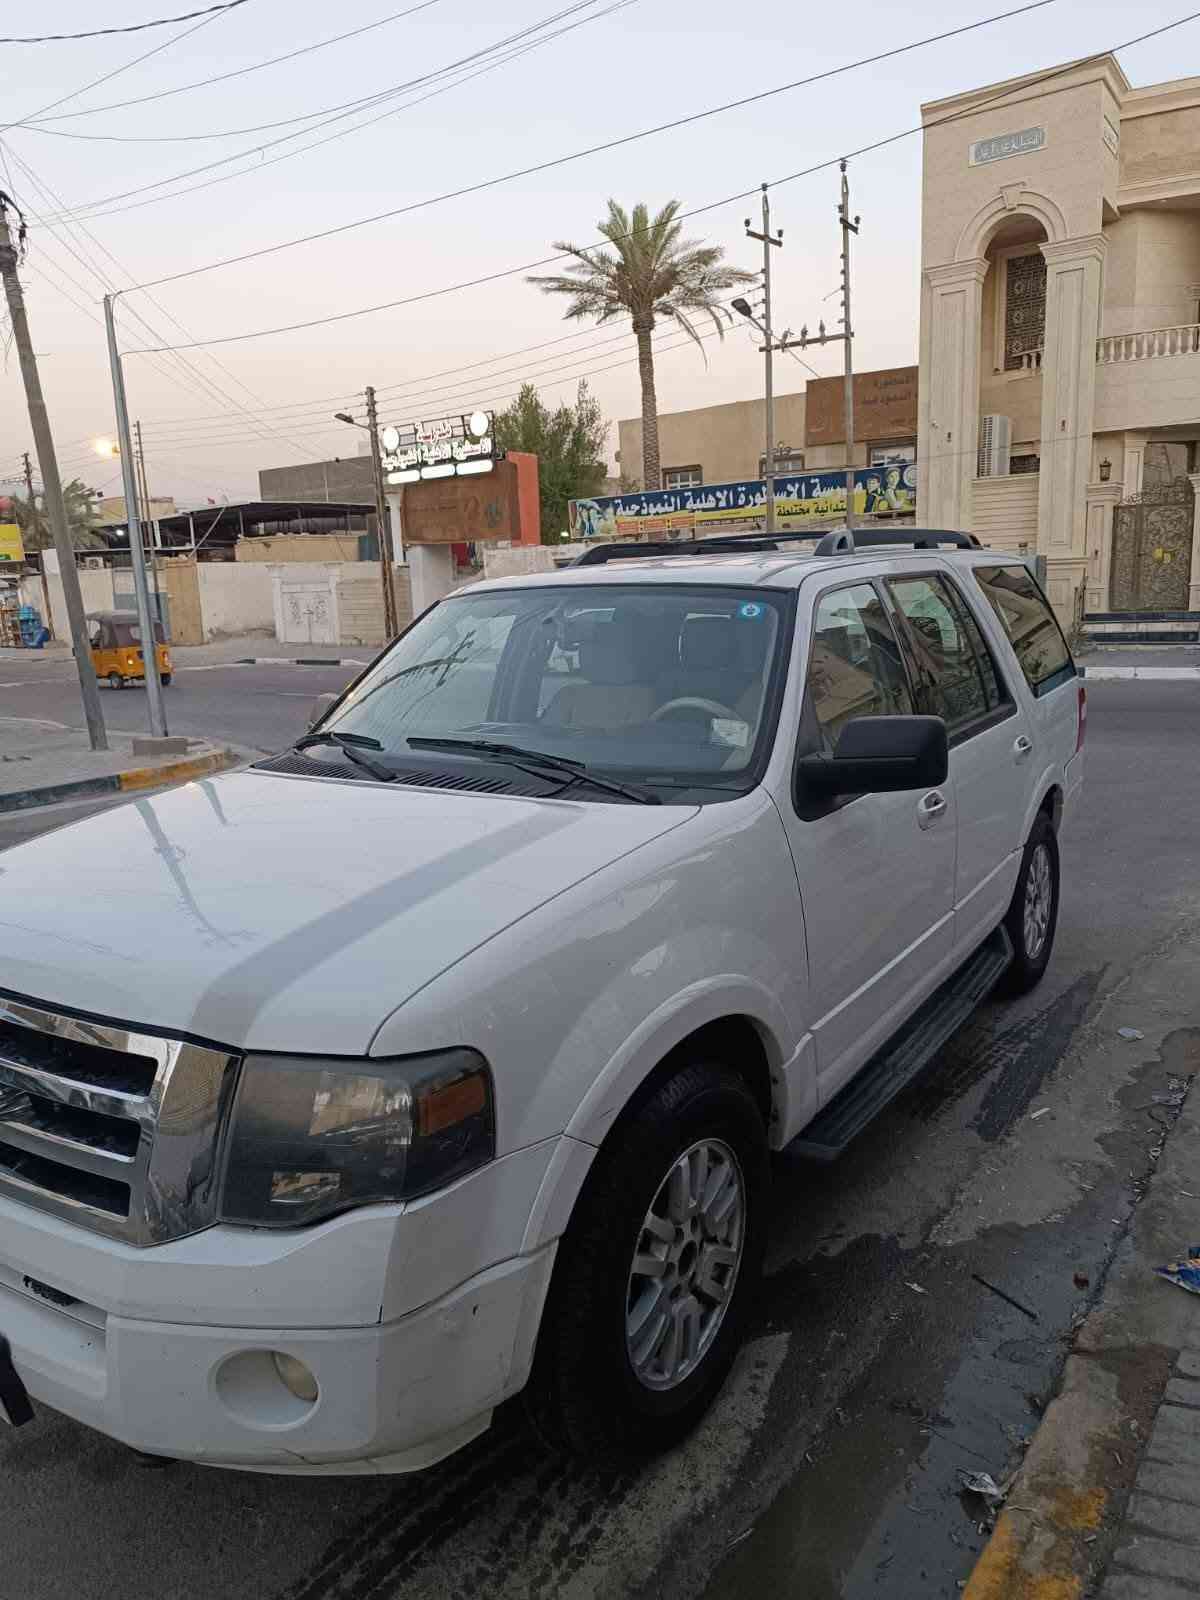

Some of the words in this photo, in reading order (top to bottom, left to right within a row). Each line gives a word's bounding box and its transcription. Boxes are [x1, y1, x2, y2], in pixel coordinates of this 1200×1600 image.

[813, 478, 863, 499] مرسة
[614, 495, 680, 516] النموذجية
[685, 490, 733, 512] الاهلية
